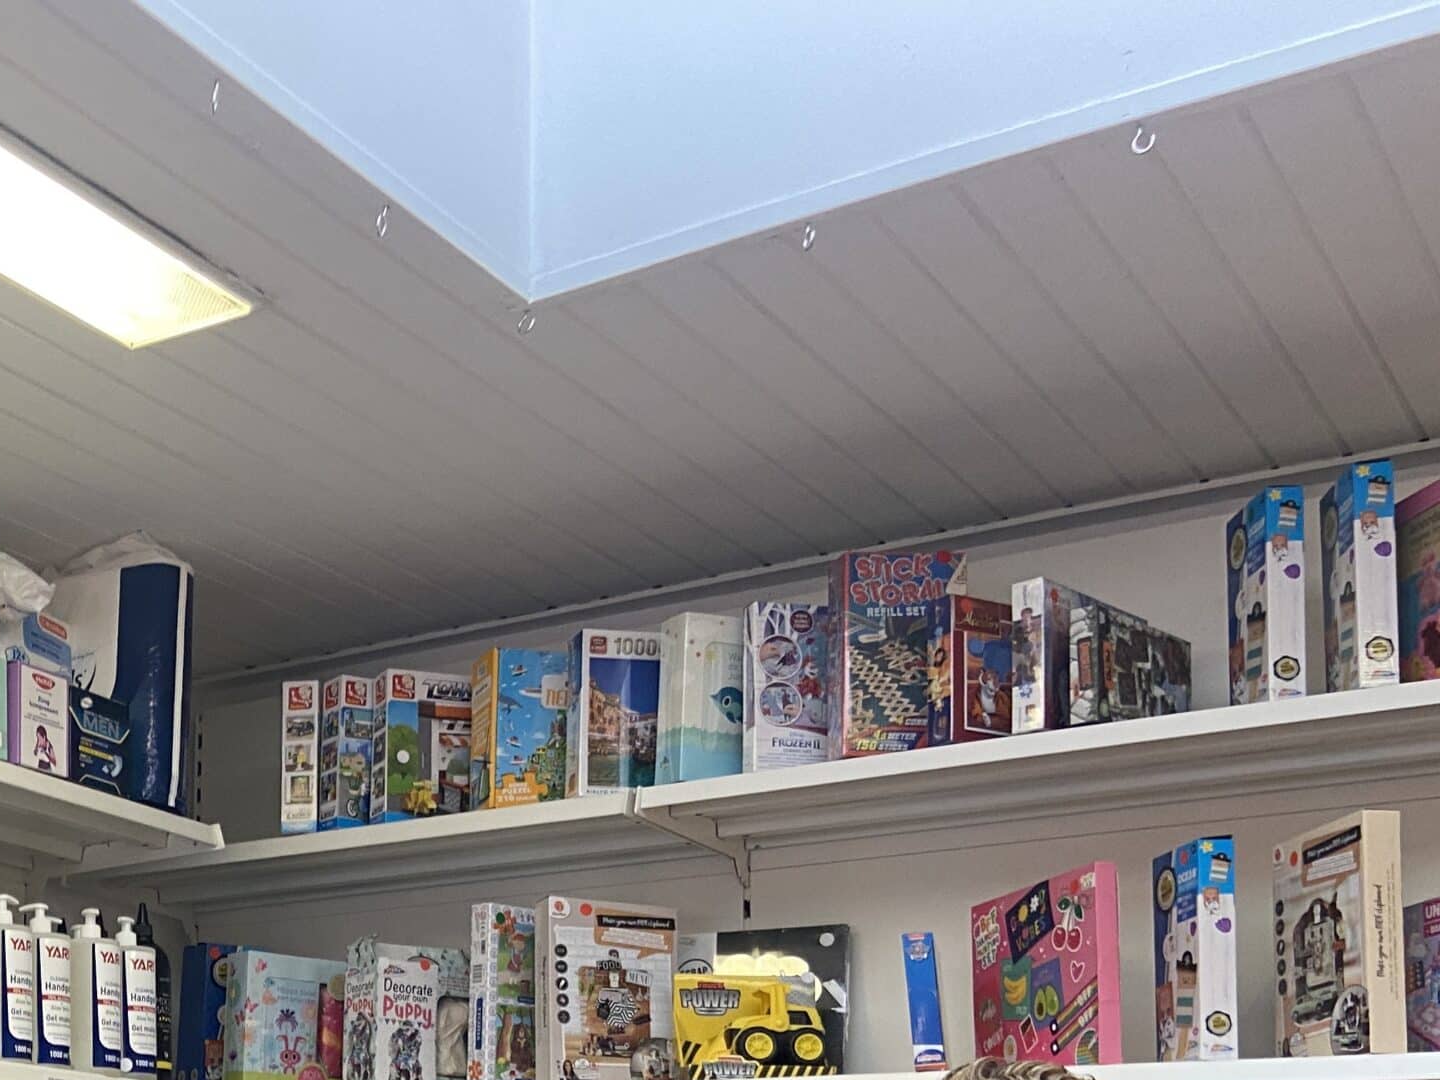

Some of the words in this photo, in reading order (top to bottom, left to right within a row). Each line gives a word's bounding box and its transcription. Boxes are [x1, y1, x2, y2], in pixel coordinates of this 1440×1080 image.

[855, 553, 933, 584] STICK
[849, 577, 944, 607] STORM
[866, 606, 904, 618] REFILL
[906, 606, 927, 617] SET
[614, 636, 658, 657] 1000
[83, 711, 120, 739] MEN
[771, 737, 811, 749] FROZEN
[384, 978, 433, 997] Decorate
[393, 994, 410, 1003] your
[680, 989, 741, 1008] POWER
[383, 995, 432, 1029] Puppy
[703, 1062, 757, 1077] POWER
